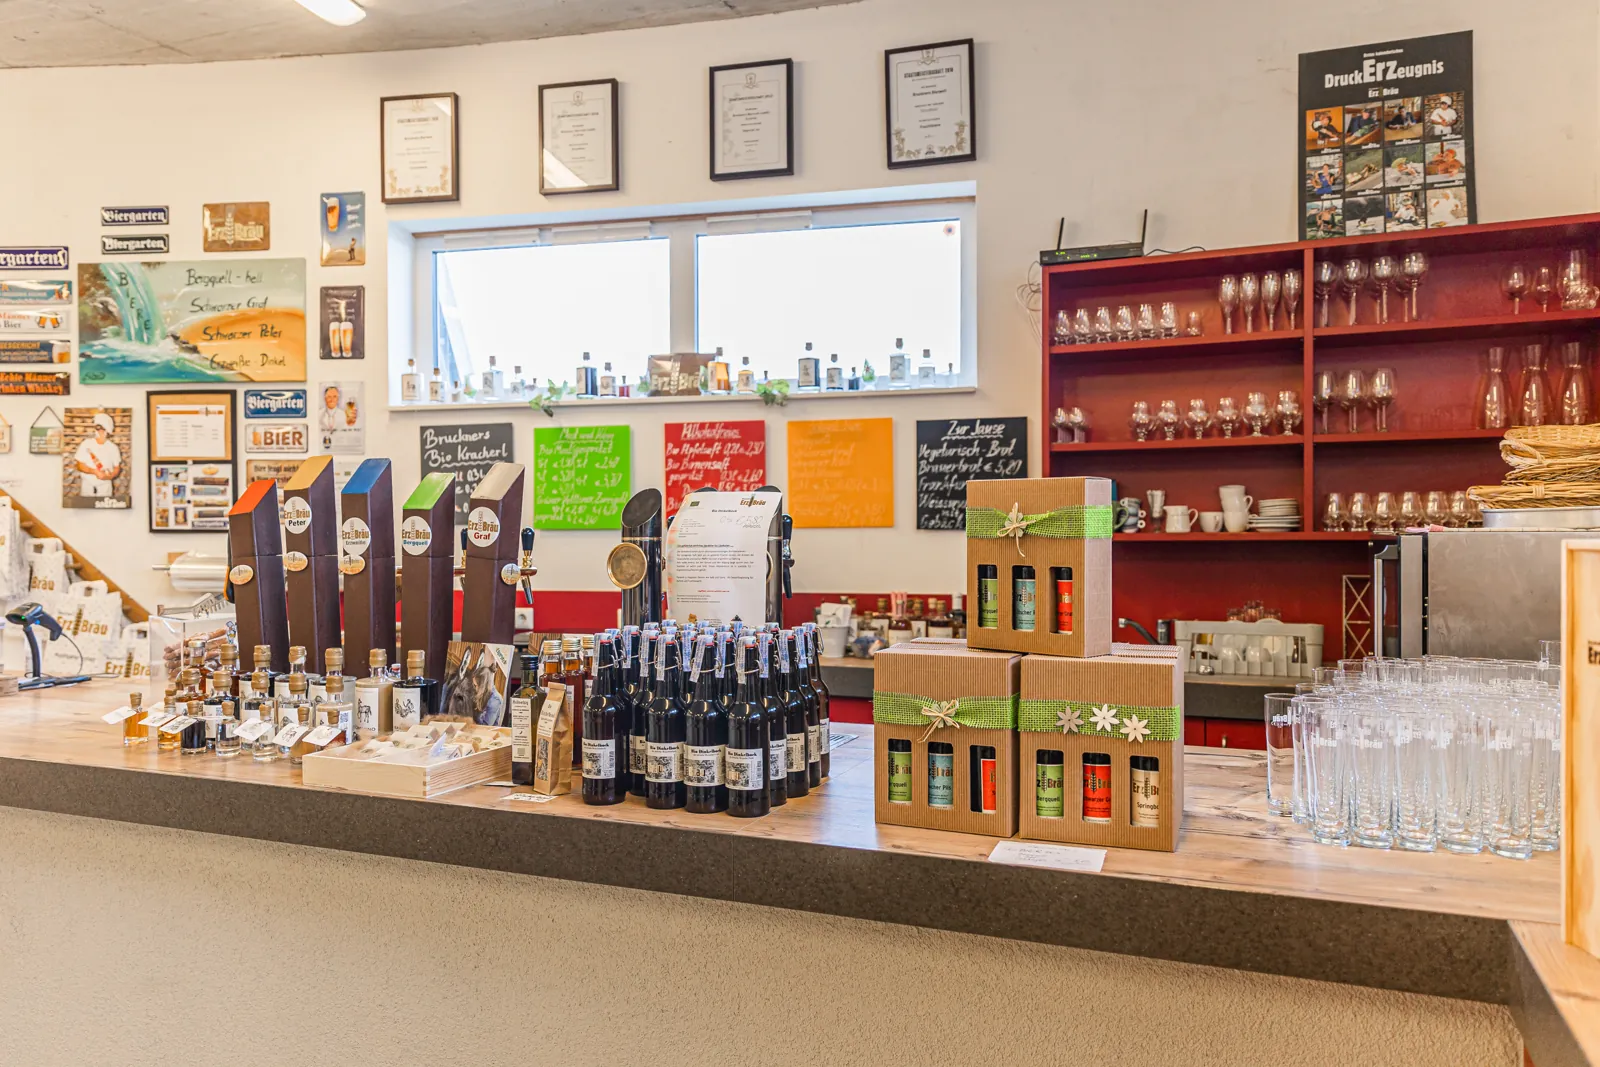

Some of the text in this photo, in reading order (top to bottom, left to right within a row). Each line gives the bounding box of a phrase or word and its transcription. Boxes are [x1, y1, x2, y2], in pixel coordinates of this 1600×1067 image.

[1368, 90, 1379, 98] Erz
[103, 209, 165, 224] Biergarten
[103, 237, 165, 251] Biergarten
[203, 323, 283, 341] Schwarzer Peter
[679, 372, 700, 391] Brä
[247, 395, 304, 412] Biergarten
[947, 419, 1006, 436] Zur Jause
[263, 431, 303, 446] BIER
[423, 428, 491, 450] Bruckners
[424, 444, 508, 468] Bio Kracherl
[283, 508, 311, 520] Erz Bräu
[288, 519, 306, 527] Peter
[467, 520, 499, 533] Erz Bräu
[342, 528, 370, 540] Erz Bräu
[401, 528, 431, 540] Erz Bräu
[473, 531, 491, 541] Graf
[81, 619, 108, 636] Bräu
[105, 661, 123, 675] Erz
